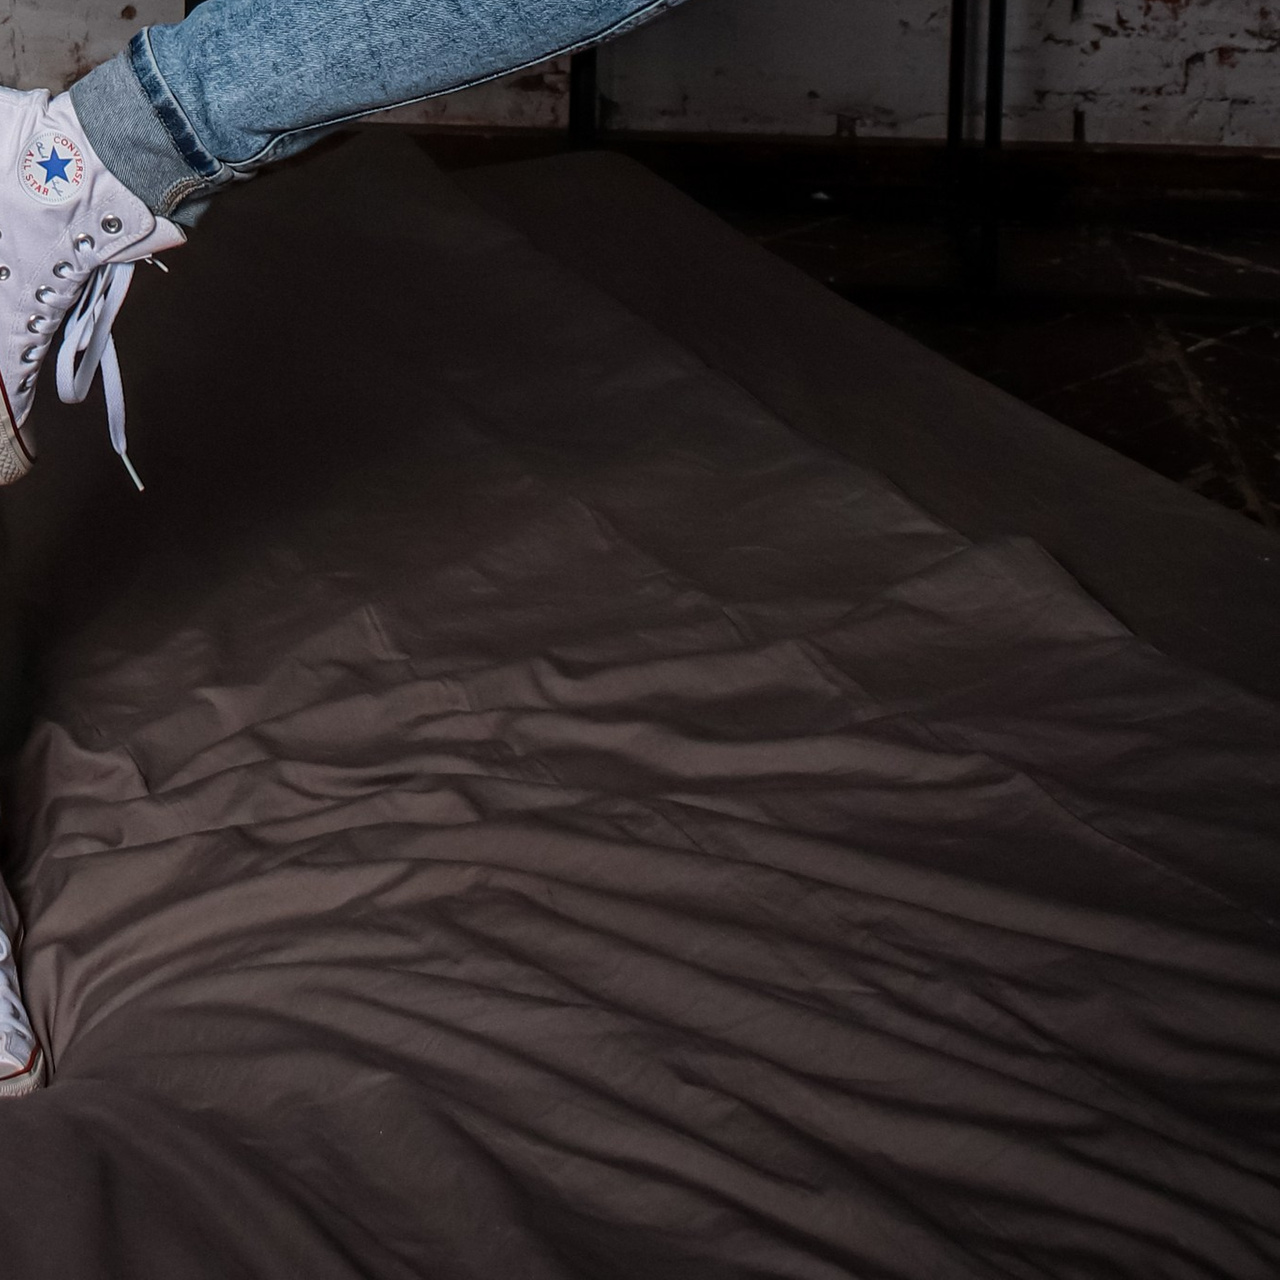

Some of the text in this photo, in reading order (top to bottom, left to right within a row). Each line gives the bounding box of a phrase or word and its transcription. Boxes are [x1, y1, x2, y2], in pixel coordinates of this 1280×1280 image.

[23, 150, 34, 170] ALL
[53, 136, 83, 186] CONVERSE
[25, 174, 49, 195] STAR
